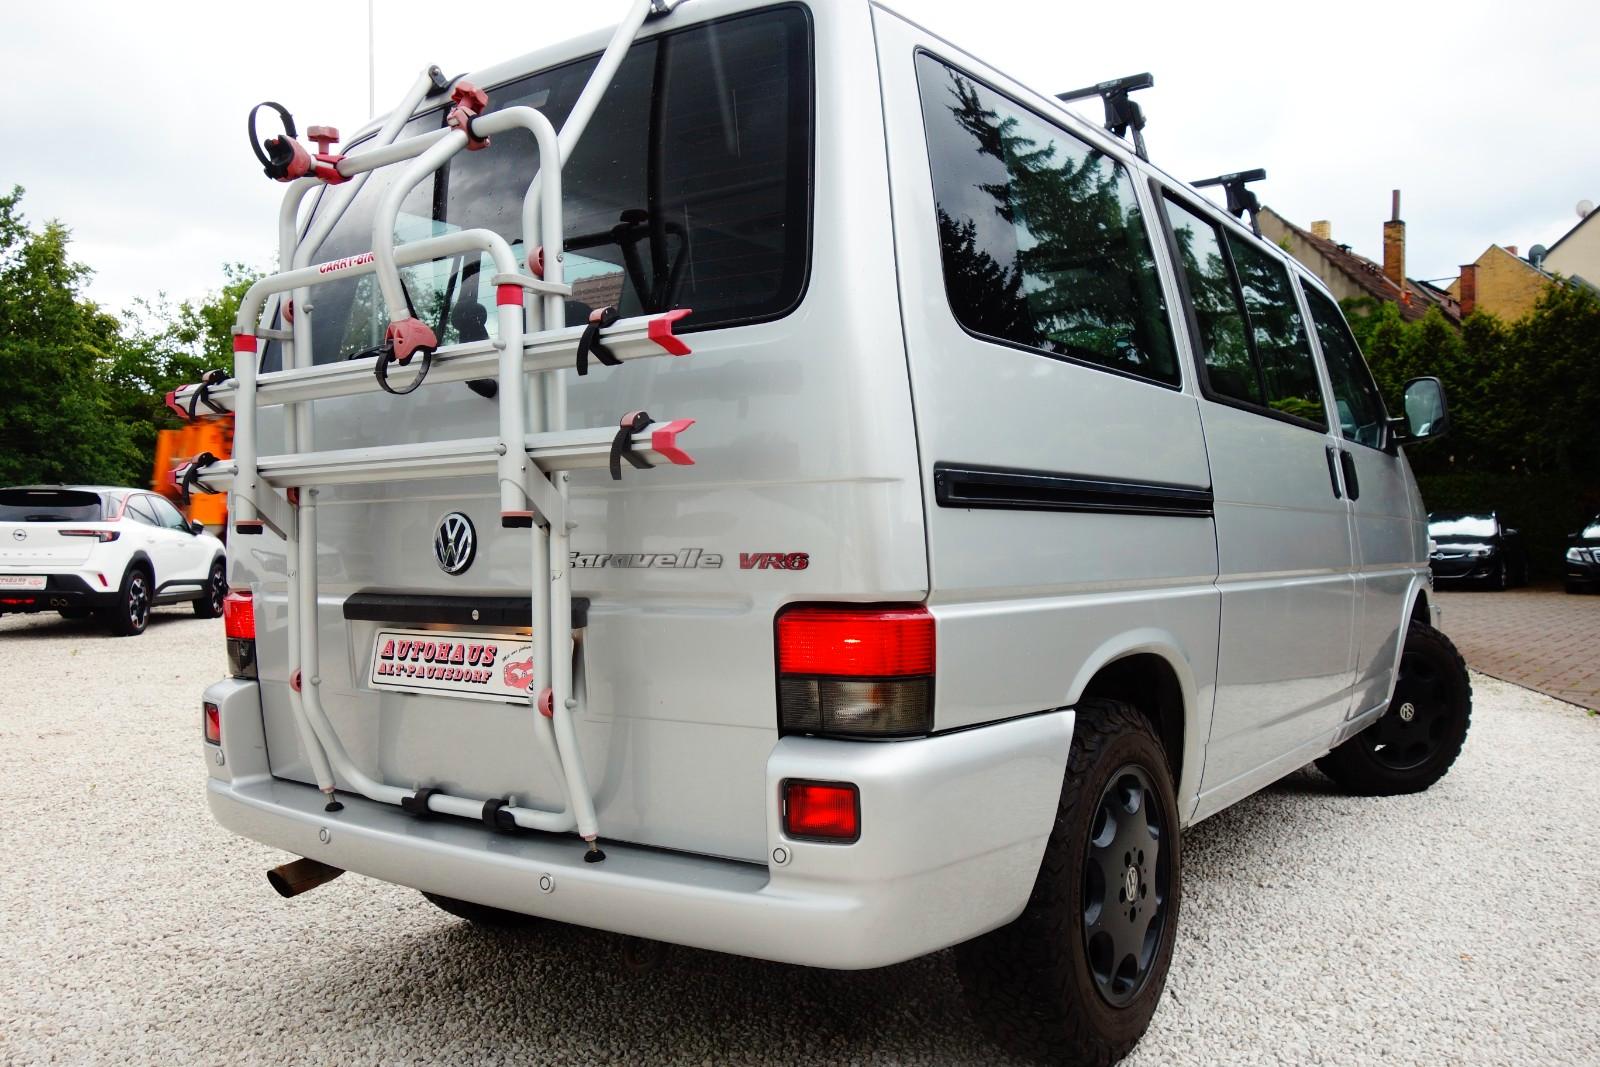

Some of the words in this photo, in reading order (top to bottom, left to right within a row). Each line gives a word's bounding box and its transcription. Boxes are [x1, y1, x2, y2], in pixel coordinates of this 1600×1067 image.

[320, 253, 375, 274] CARRY-BIK
[739, 552, 810, 570] VR6
[380, 639, 497, 667] AUTOHAUS
[377, 663, 493, 685] ALT-PAUNSDORF
